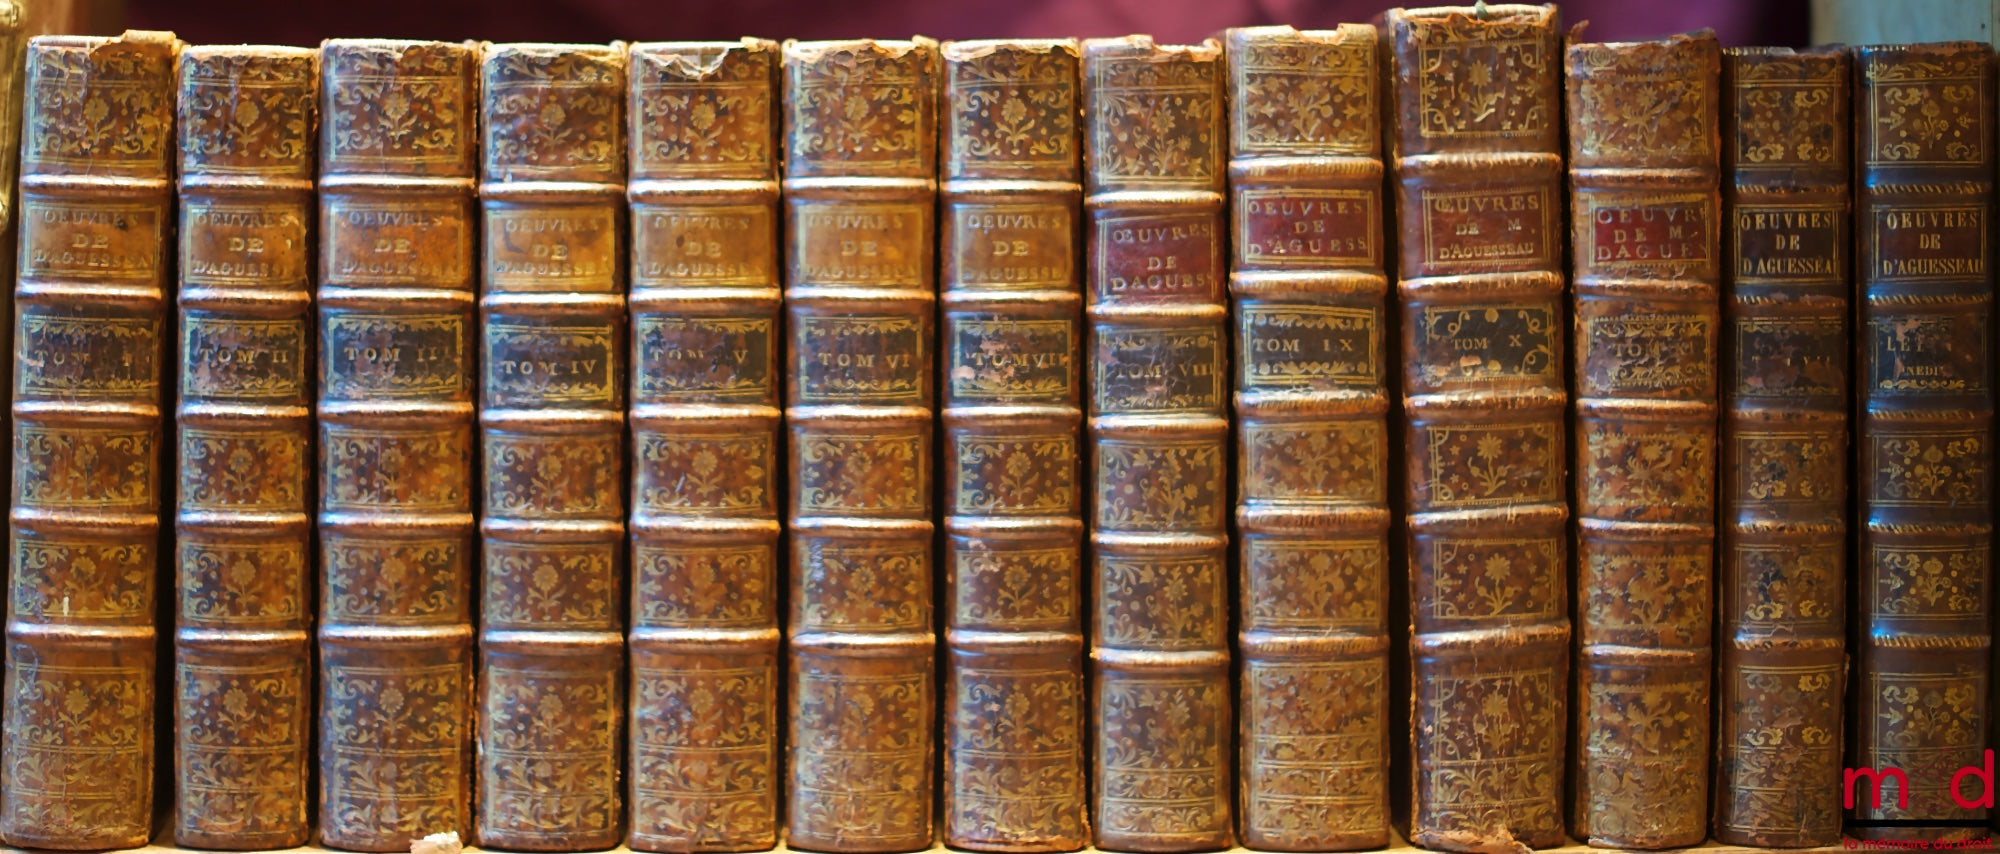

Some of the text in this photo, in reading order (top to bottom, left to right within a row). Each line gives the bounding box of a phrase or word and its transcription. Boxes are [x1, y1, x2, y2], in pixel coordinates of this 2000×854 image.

[1248, 201, 1362, 216] OEUVRES
[1294, 219, 1325, 234] DE
[1455, 221, 1480, 236] DE
[1740, 212, 1831, 231] OEUVRES
[1886, 211, 1977, 230] OEUVRES
[72, 233, 109, 249] DE
[1613, 227, 1647, 244] DE
[1775, 234, 1800, 251] DE
[1919, 233, 1941, 250] DE
[228, 237, 264, 253] DE
[374, 238, 411, 254] DE
[533, 244, 567, 260] DE
[685, 241, 721, 258] DE
[840, 240, 877, 257] DE
[992, 240, 1030, 256] DE
[1147, 255, 1177, 272] DE
[1252, 338, 1353, 353] TOM IX
[1453, 334, 1523, 351] TOM X
[199, 348, 289, 364] TOM II
[344, 347, 400, 363] TOM
[732, 349, 748, 365] V
[817, 352, 911, 369] TOM VI
[501, 359, 598, 377] TOM IV
